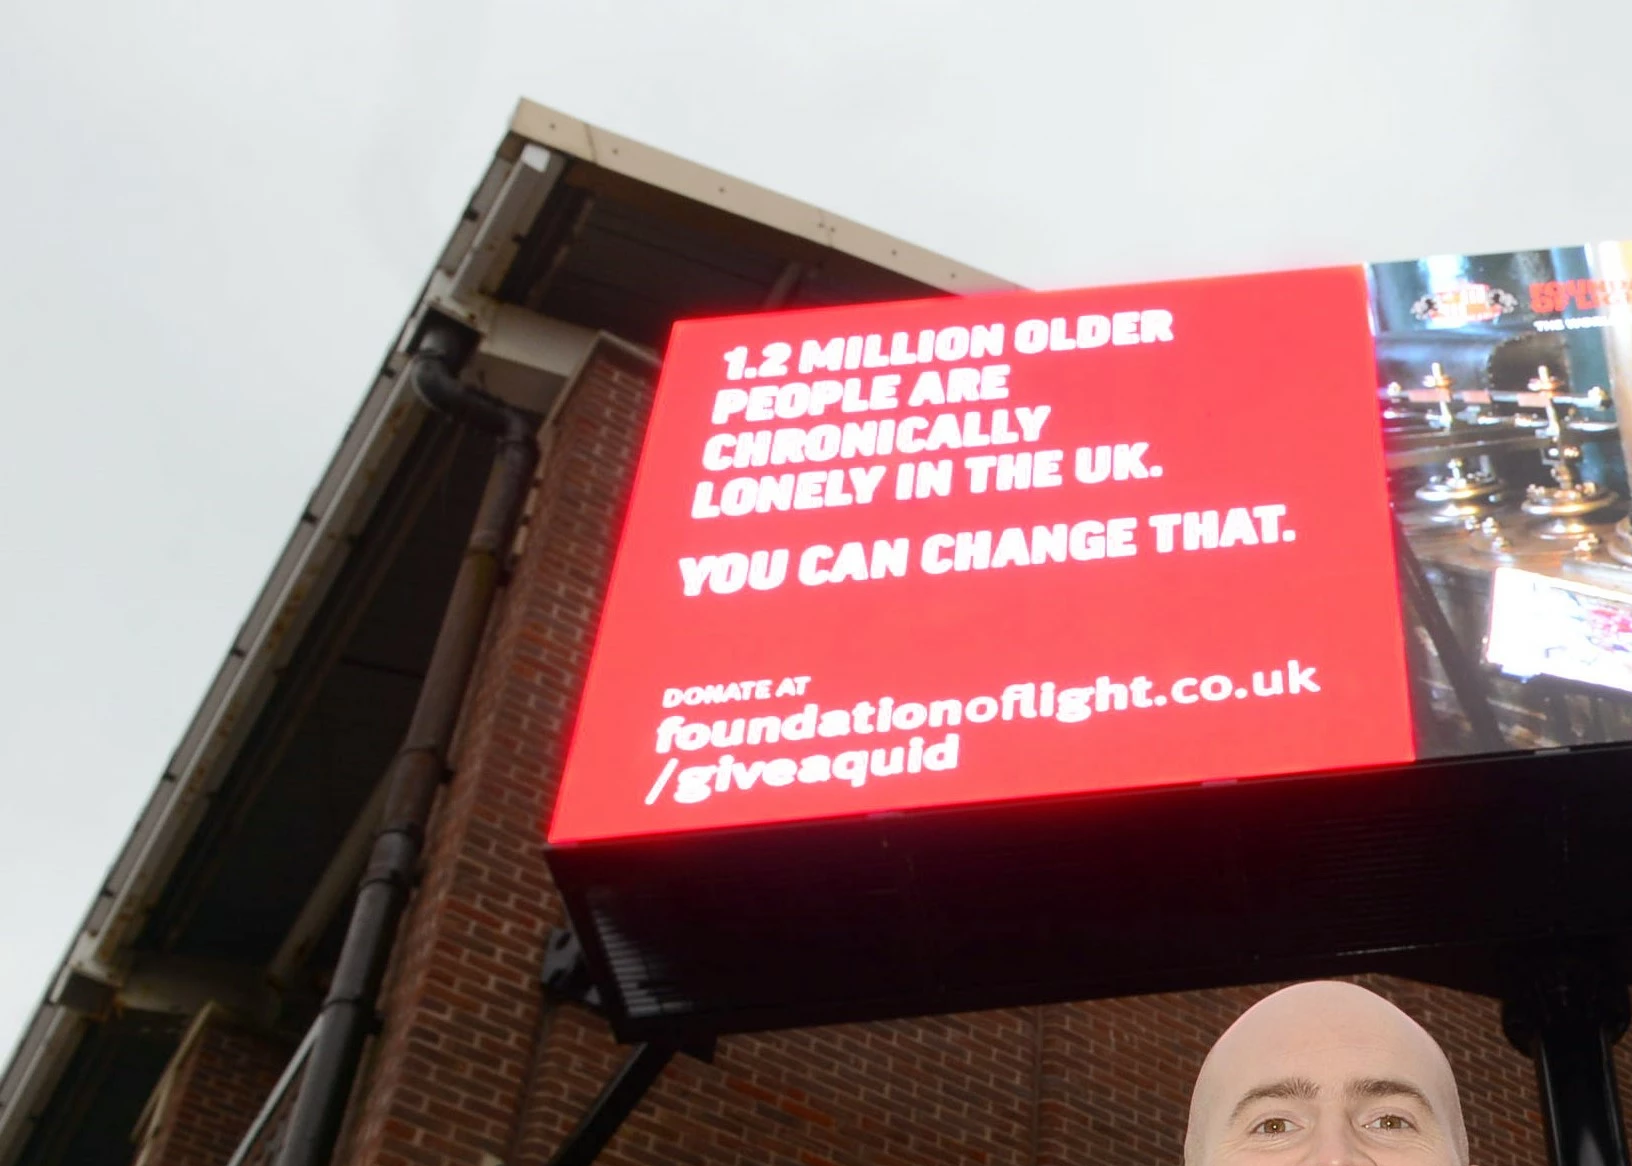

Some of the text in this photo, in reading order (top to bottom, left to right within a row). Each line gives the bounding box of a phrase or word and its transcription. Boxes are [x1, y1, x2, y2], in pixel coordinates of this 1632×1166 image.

[722, 309, 1174, 381] 1.2 MILLION OLDER
[711, 363, 1011, 425] PEOPLE ARE
[701, 404, 1052, 472] CHRONICALLY
[690, 441, 1164, 520] LONELY IN THE UK.
[678, 503, 1297, 597] YOU CAN CHANGE THAT.
[655, 659, 1321, 754] foundationoflight.co.uk
[661, 675, 812, 709] DONATE AT
[644, 732, 960, 806] /giveaquid
